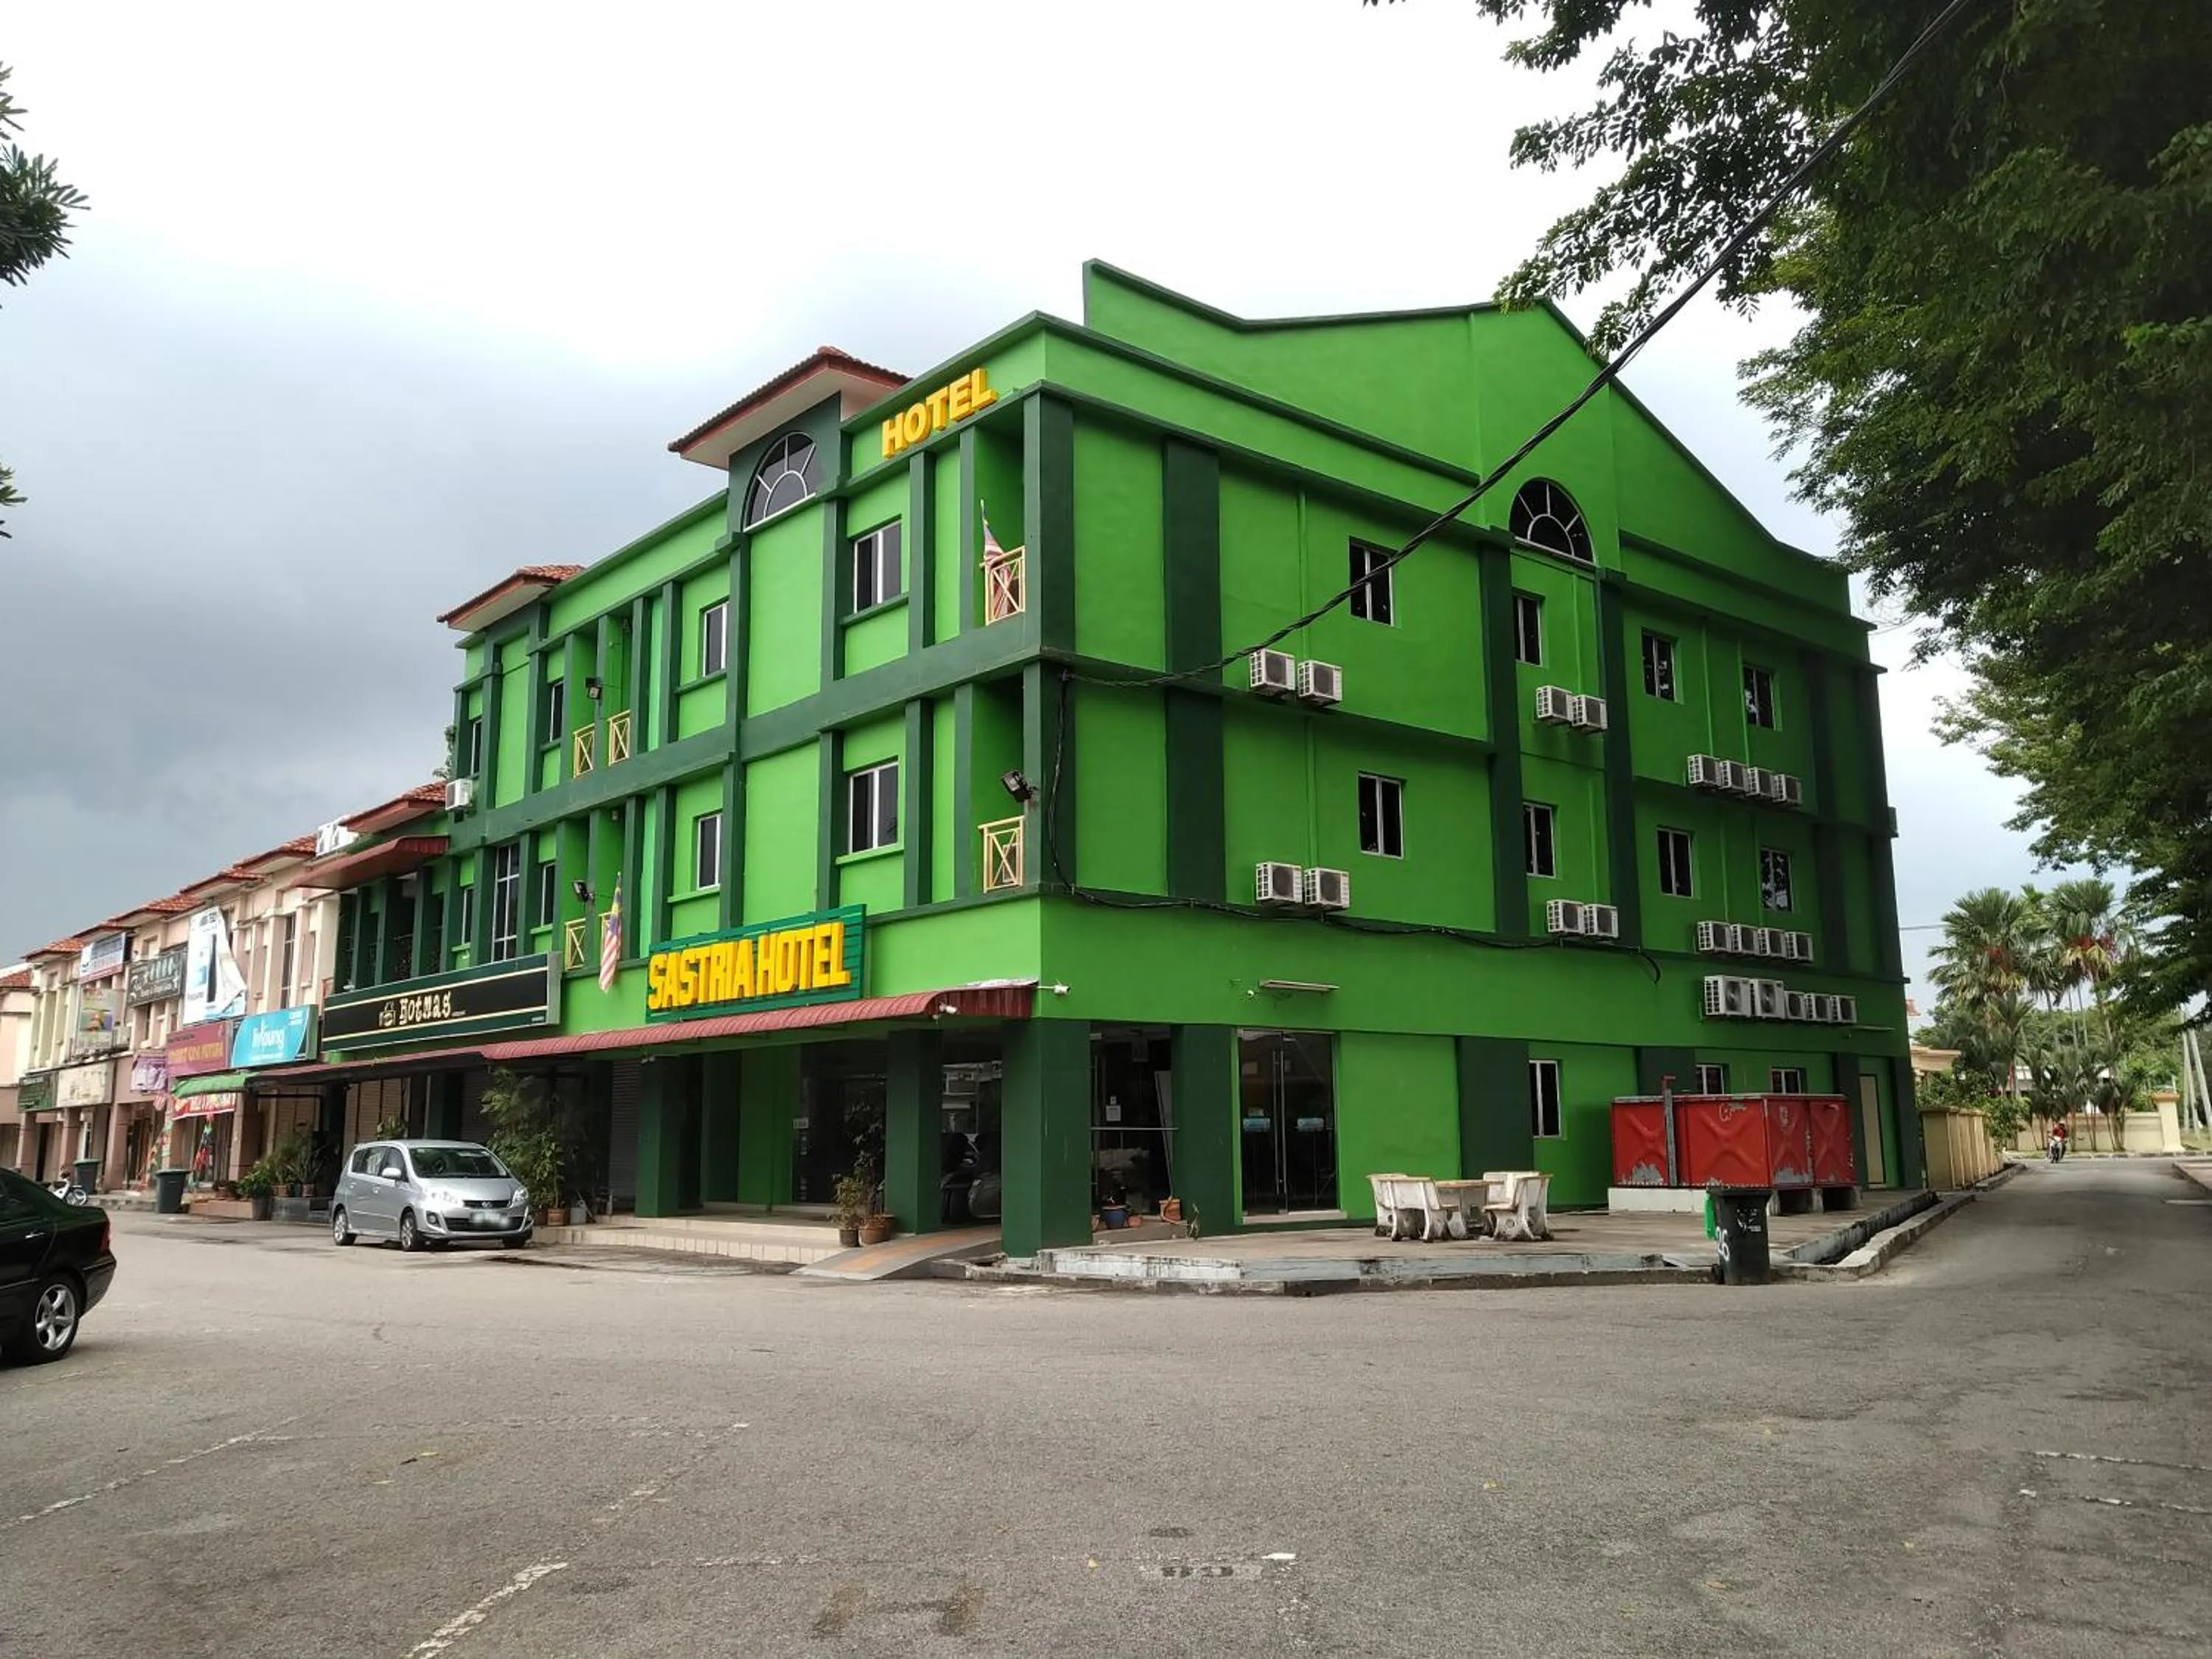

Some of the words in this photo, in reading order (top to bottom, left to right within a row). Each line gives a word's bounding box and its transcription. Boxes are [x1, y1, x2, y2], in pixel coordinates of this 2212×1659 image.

[882, 368, 997, 459] HOTEL
[648, 939, 756, 1010] SASTRIA
[757, 922, 851, 995] HOTEL
